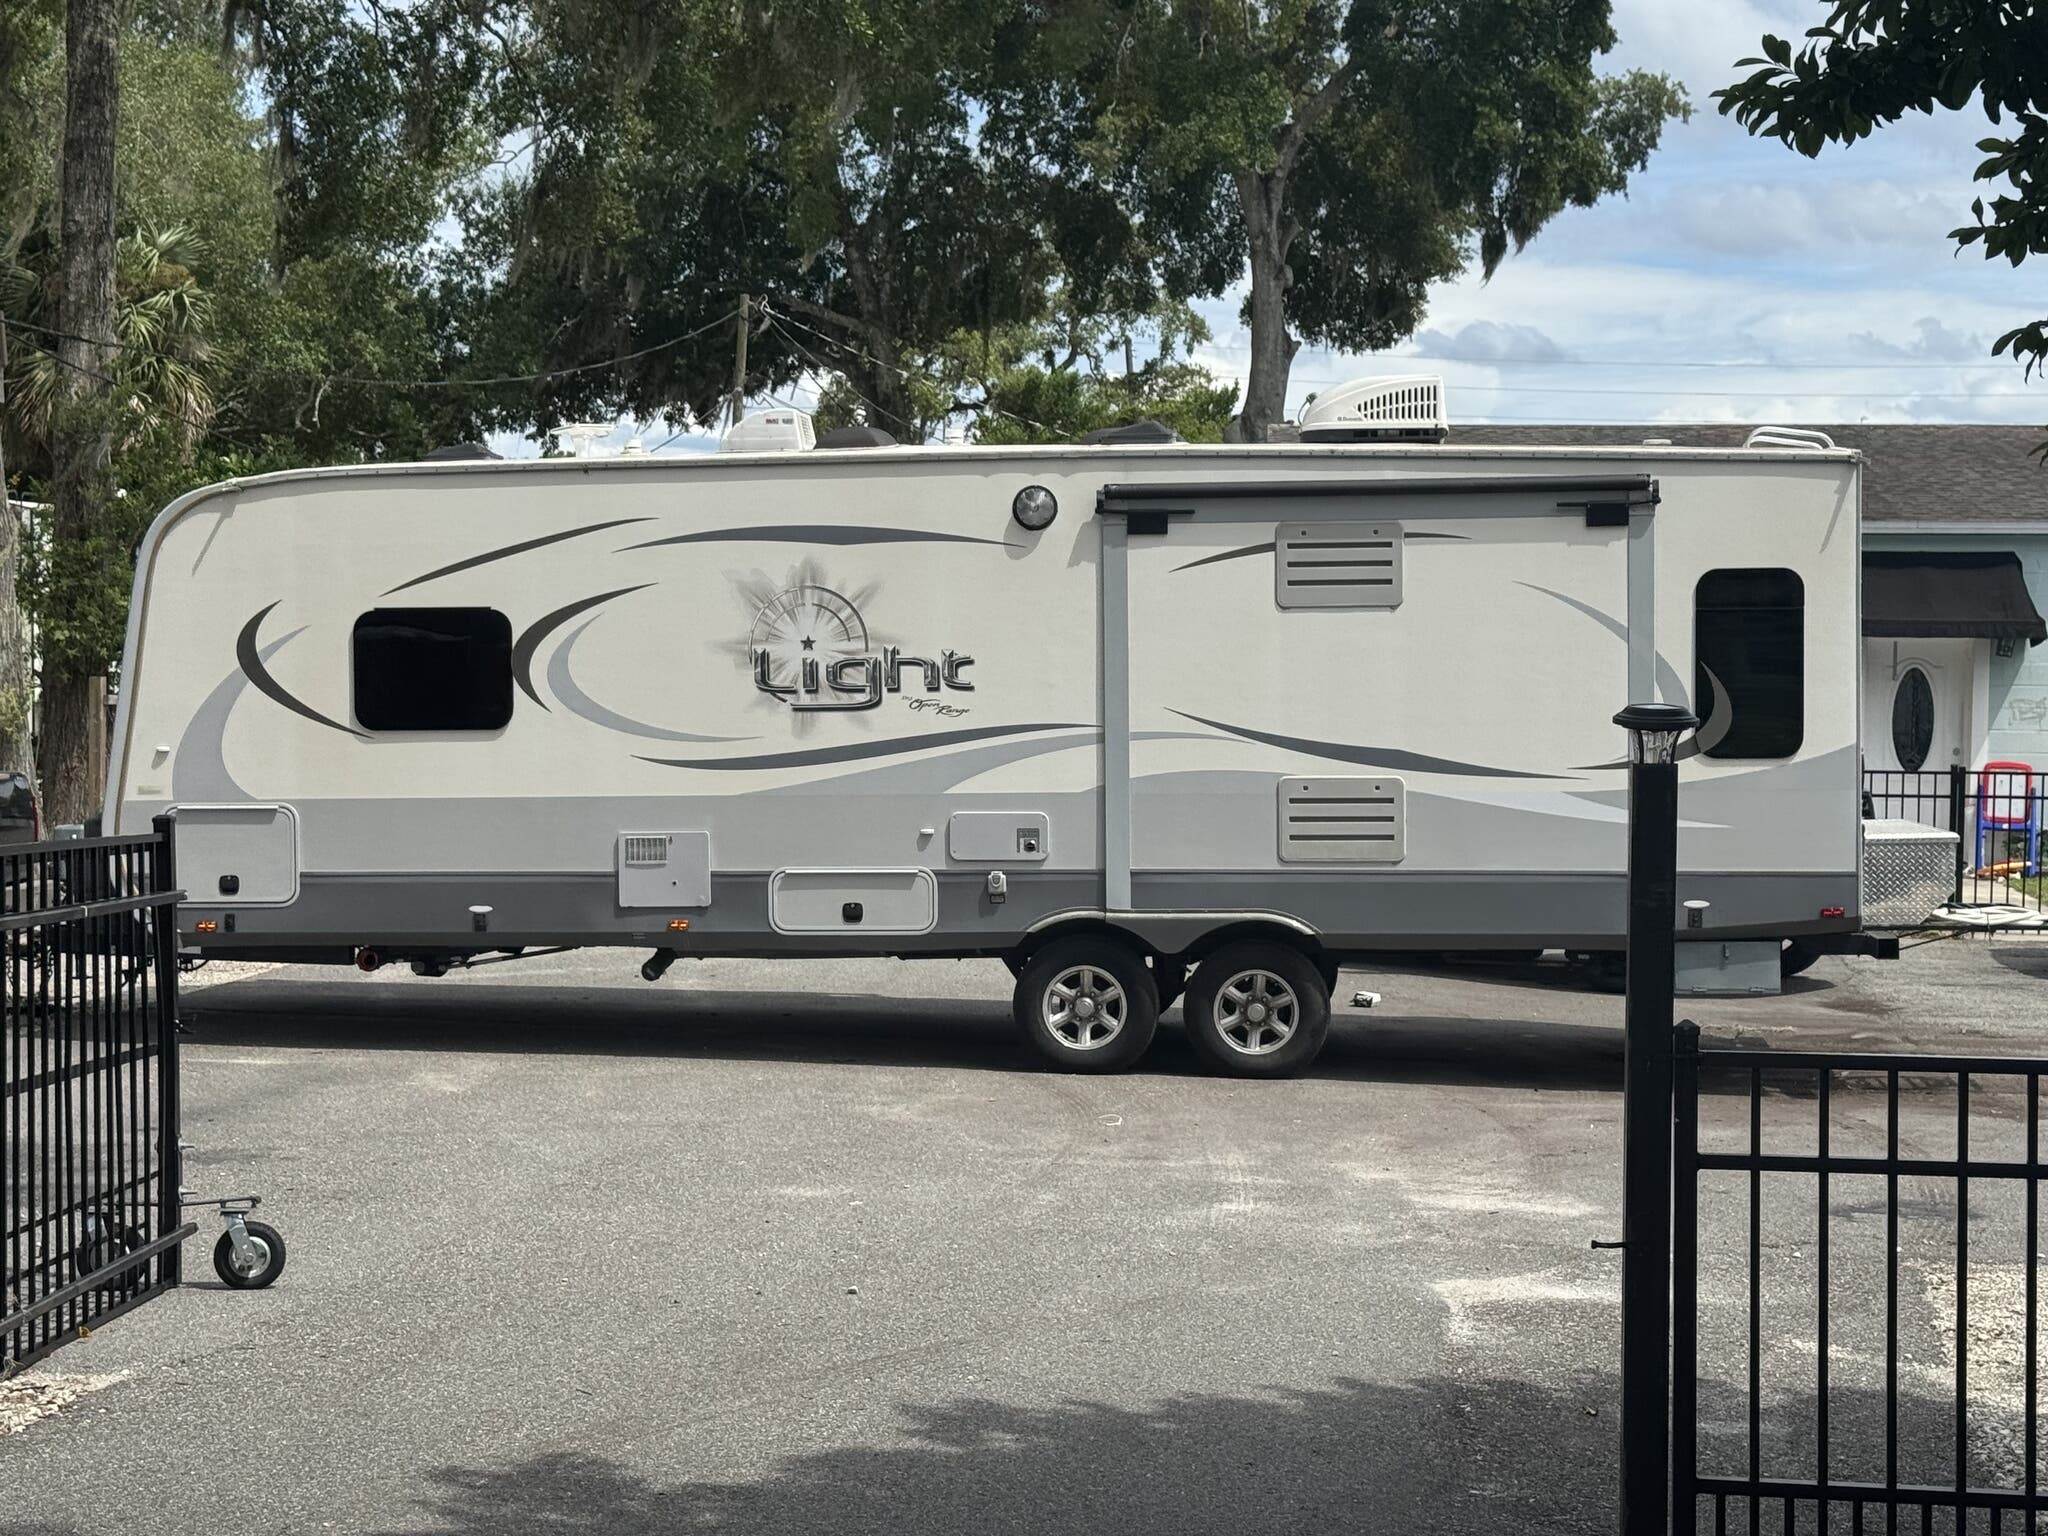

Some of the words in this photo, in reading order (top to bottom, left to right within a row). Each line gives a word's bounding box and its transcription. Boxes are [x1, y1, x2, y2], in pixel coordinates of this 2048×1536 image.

[754, 645, 975, 711] Light
[909, 698, 941, 712] Open
[933, 704, 971, 717] Range
